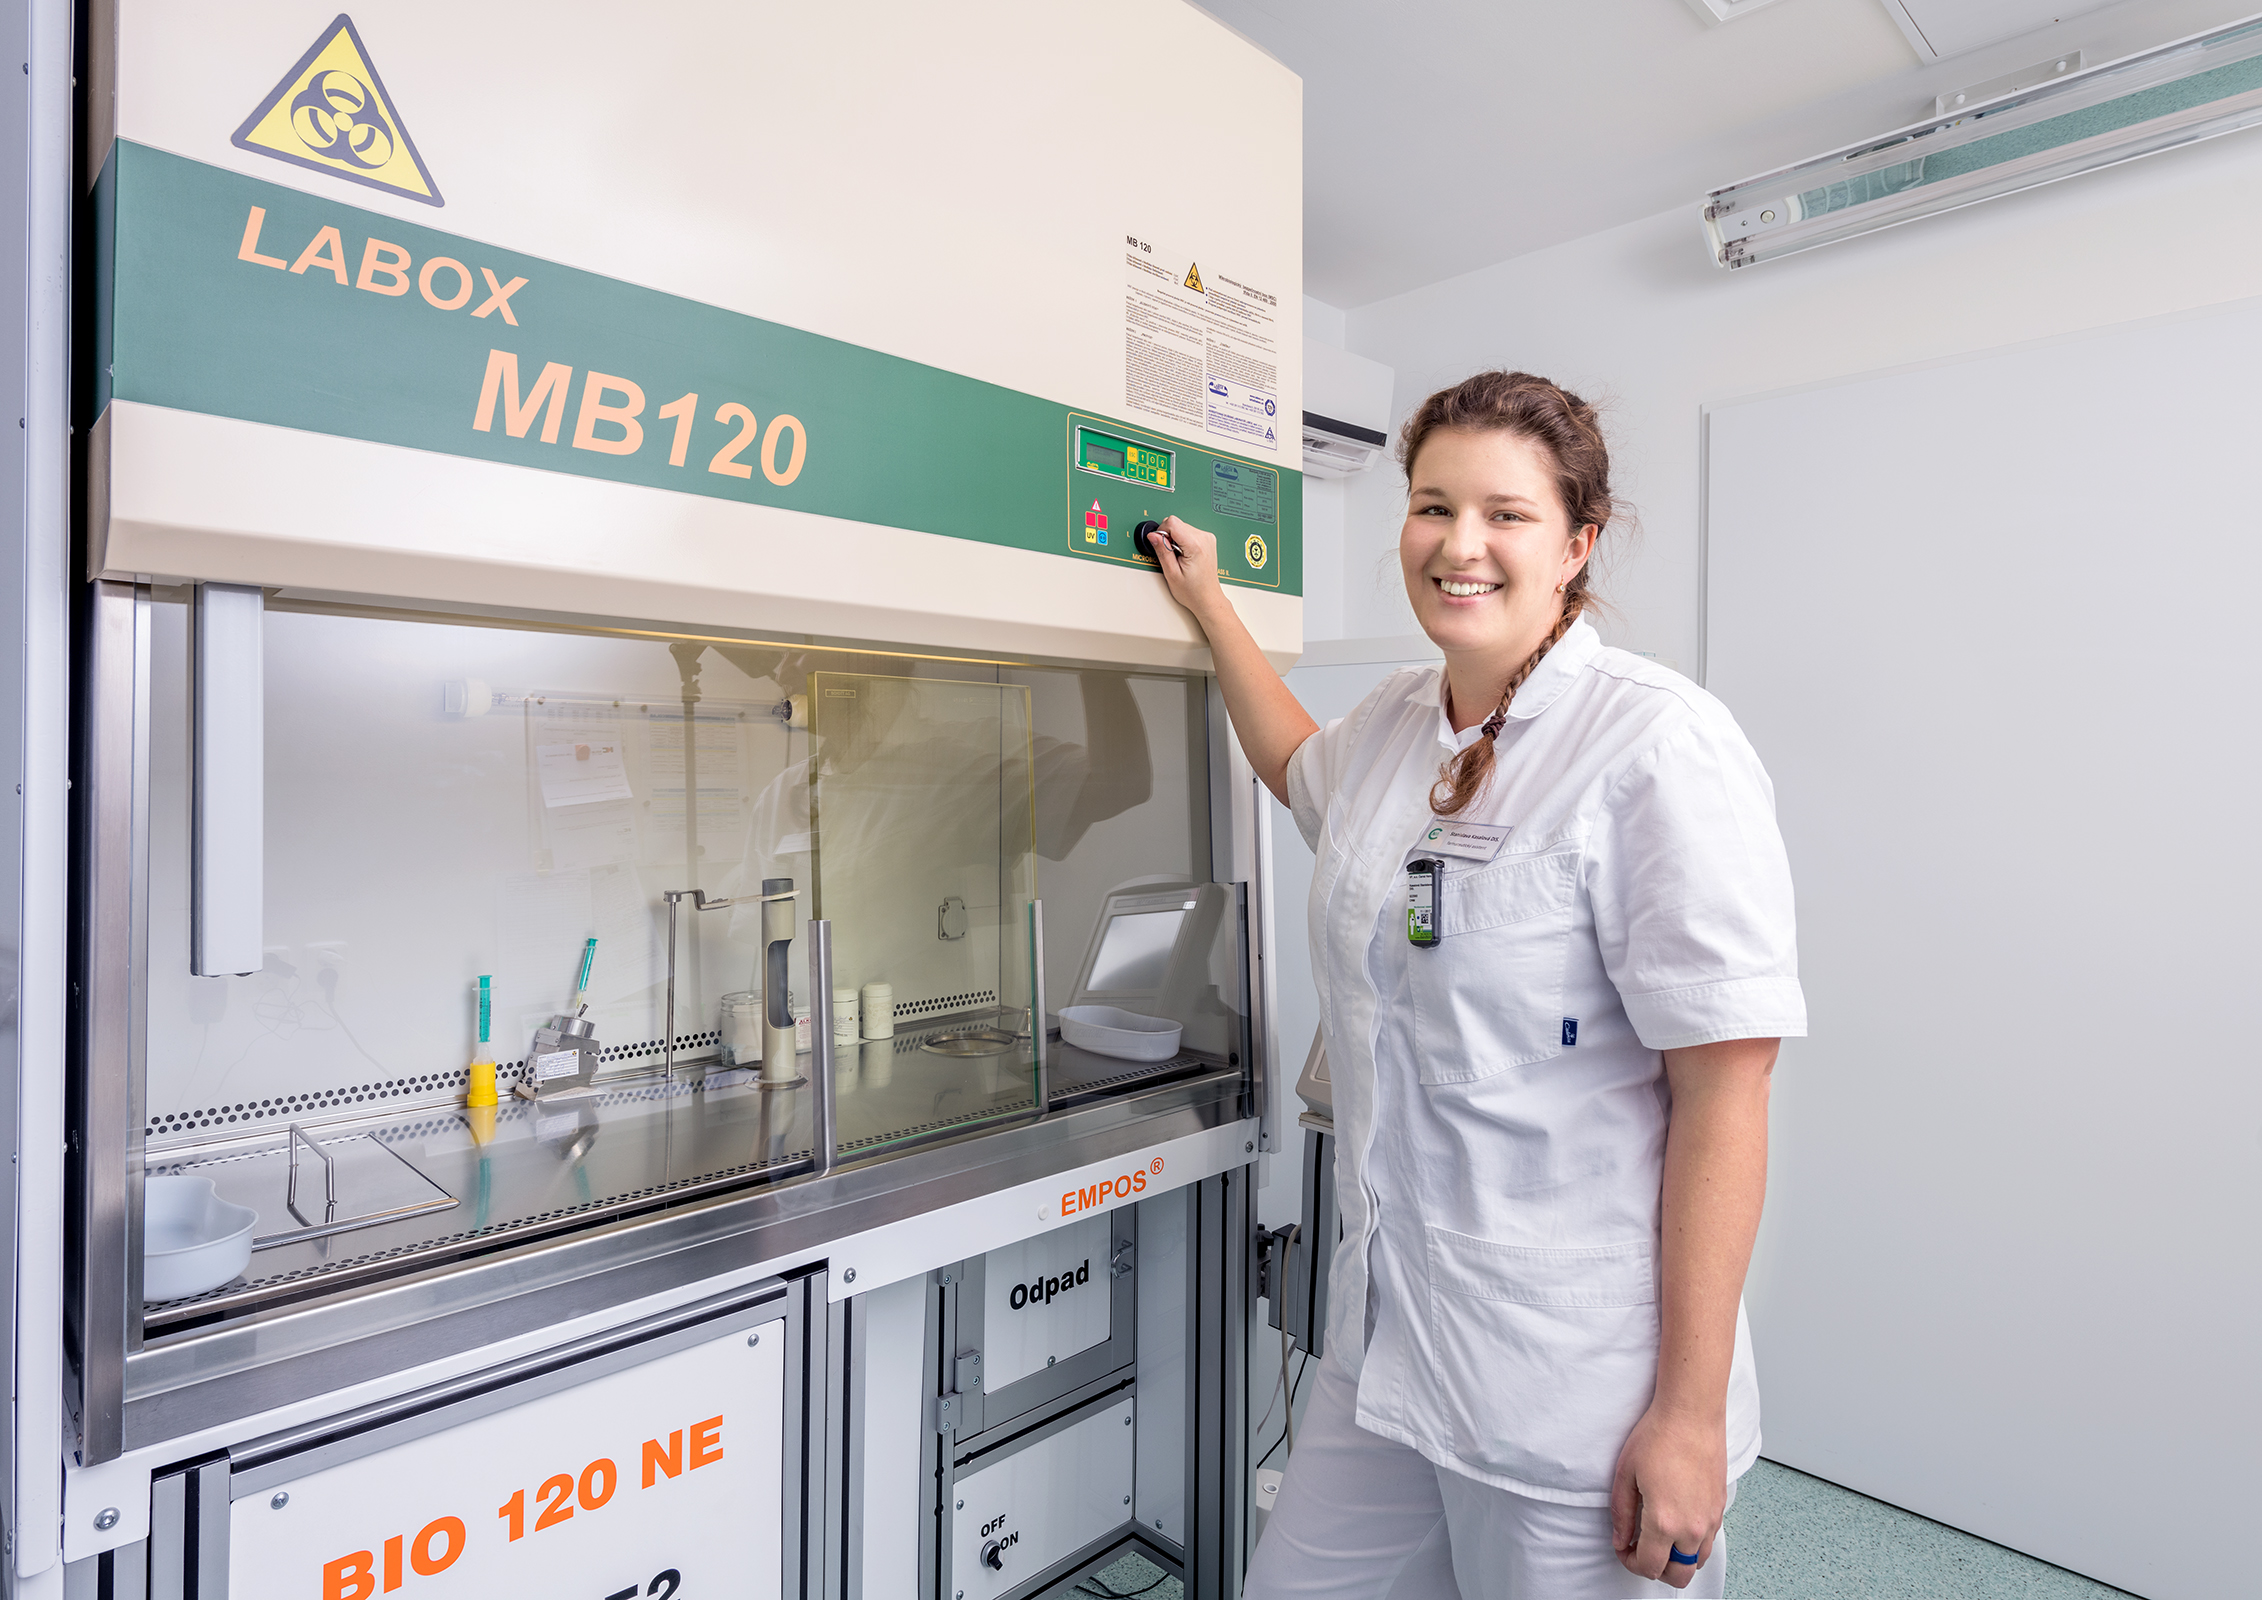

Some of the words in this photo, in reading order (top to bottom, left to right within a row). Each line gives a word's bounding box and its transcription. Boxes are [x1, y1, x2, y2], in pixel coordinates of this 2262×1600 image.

[1126, 235, 1138, 248] MB
[1139, 241, 1152, 254] 120
[237, 206, 530, 326] LABOX
[473, 349, 807, 486] MB120
[1132, 553, 1159, 564] MICROBIO
[1009, 1259, 1089, 1309] Odpad
[323, 1515, 466, 1600] BIO
[499, 1458, 617, 1543] 120
[641, 1414, 724, 1490] NE
[981, 1513, 1007, 1538] OFF
[1000, 1530, 1019, 1551] ON
